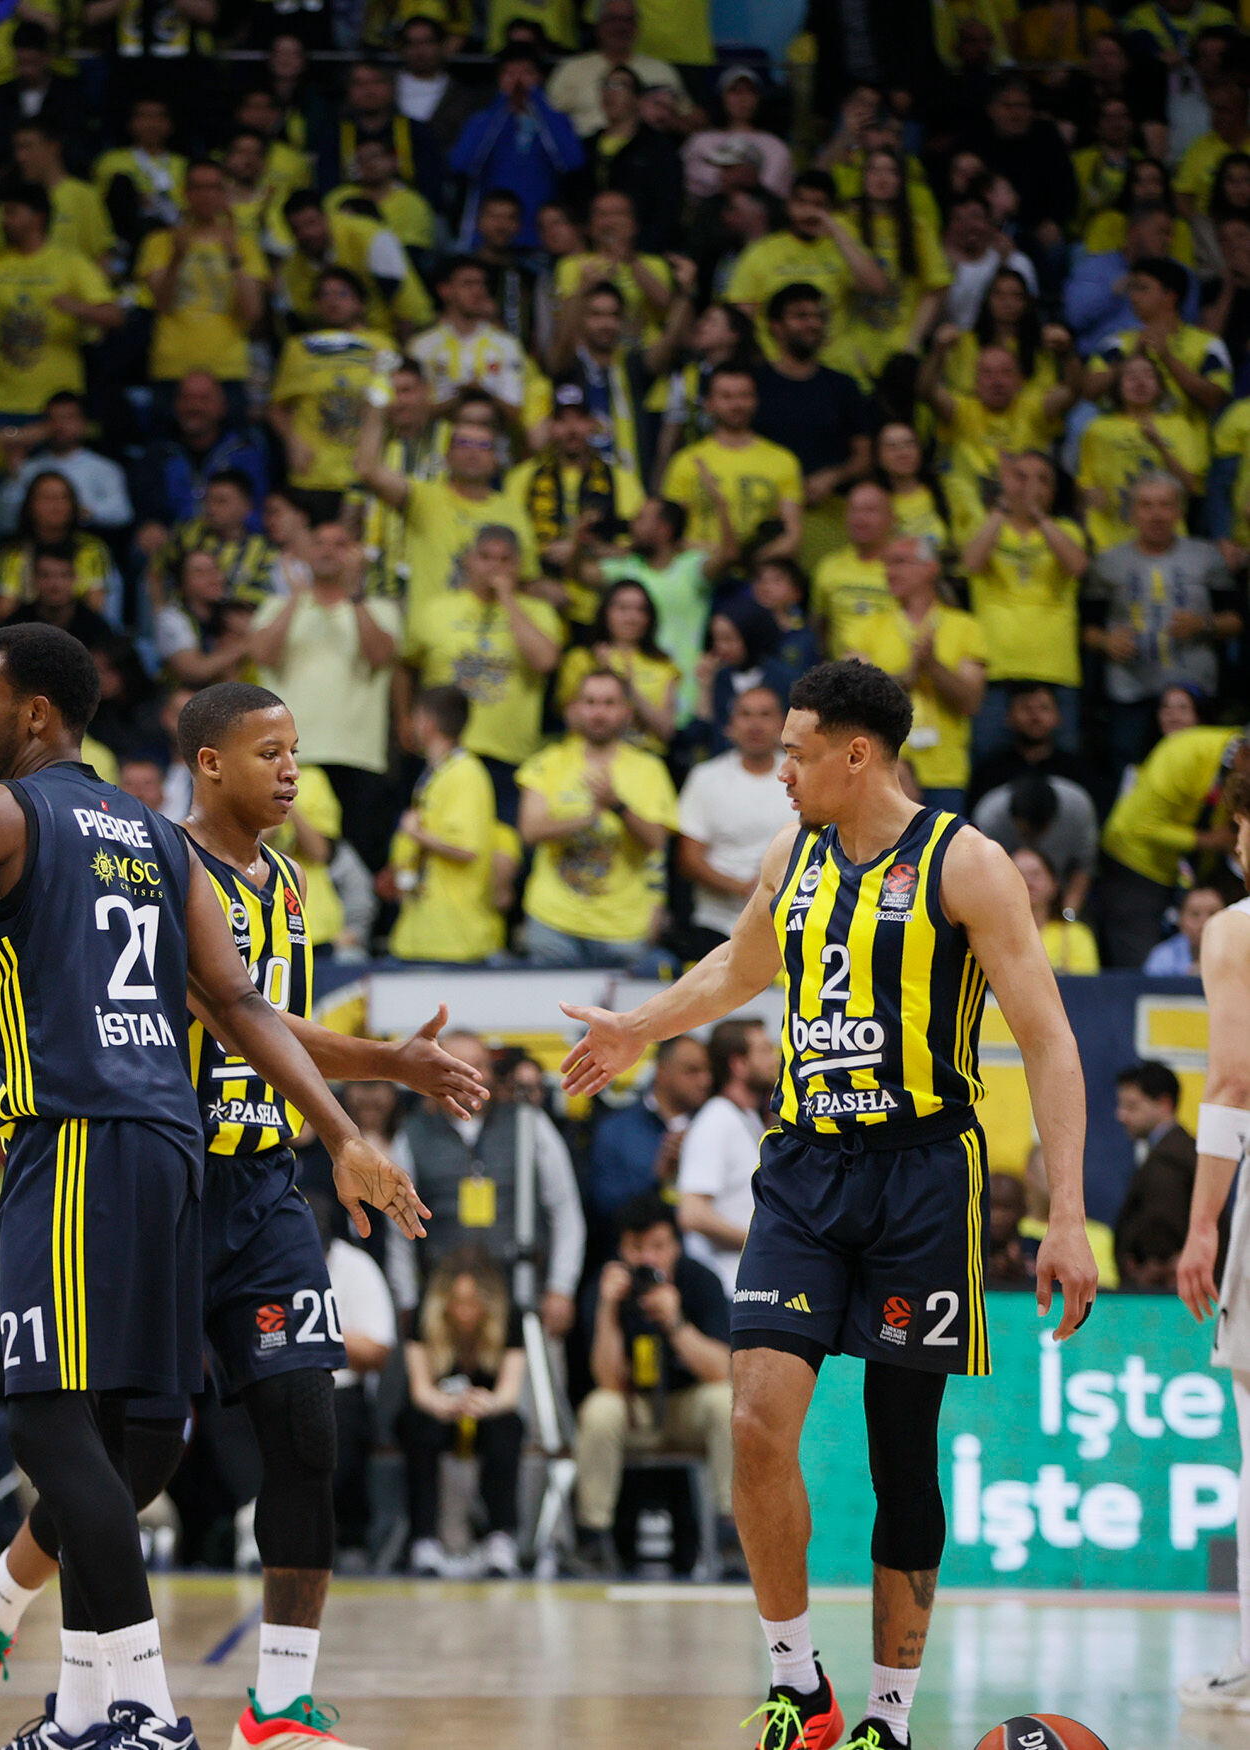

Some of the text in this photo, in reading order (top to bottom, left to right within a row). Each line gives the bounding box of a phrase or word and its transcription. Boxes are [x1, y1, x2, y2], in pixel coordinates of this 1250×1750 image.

[72, 808, 153, 849] PIERRE
[113, 855, 162, 886] MSC
[792, 895, 815, 905] beko
[874, 911, 913, 922] oneteam
[94, 894, 160, 1000] 21
[818, 943, 851, 1001] 2
[792, 1011, 886, 1052] beko
[228, 1100, 284, 1126] PASHA
[815, 1088, 899, 1115] PASHA
[292, 1287, 345, 1344] 20
[922, 1290, 959, 1346] 2
[0, 1306, 47, 1370] 21
[1038, 1328, 1226, 1461] İşte
[952, 1432, 1143, 1572] İşte
[261, 1647, 309, 1659] adidas
